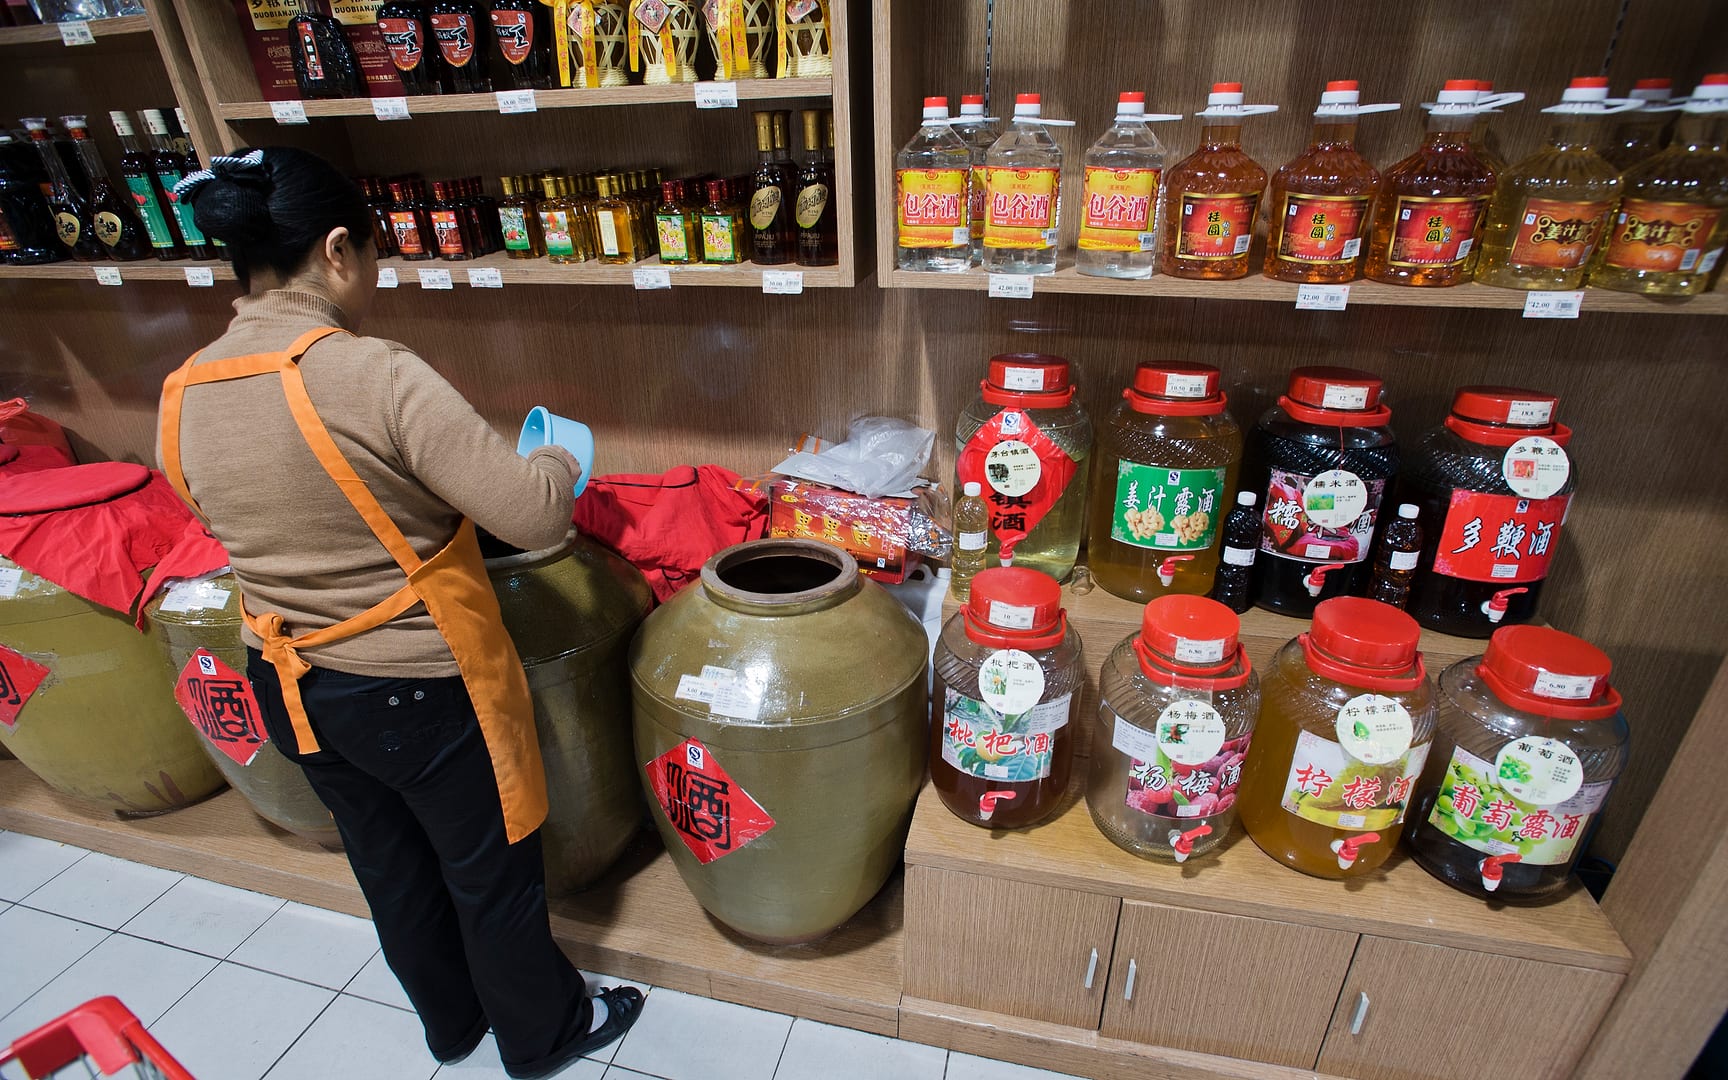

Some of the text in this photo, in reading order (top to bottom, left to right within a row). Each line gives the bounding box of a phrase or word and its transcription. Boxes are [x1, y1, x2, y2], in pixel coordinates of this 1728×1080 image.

[904, 192, 960, 219] 包谷酒
[993, 192, 1051, 219] 包谷酒
[1088, 192, 1150, 223] 包谷酒
[1515, 446, 1561, 456] 多鞭酒
[1313, 479, 1358, 488] 糯米酒
[1122, 480, 1216, 516] 姜汁露酒
[1452, 517, 1555, 560] 多鞭酒
[991, 658, 1035, 671] 枇杷酒
[1167, 710, 1215, 721] 杨梅酒
[1345, 703, 1397, 717] 柠檬酒
[948, 717, 1050, 756] 枇杷酒
[1517, 741, 1576, 766] 葡萄酒
[1135, 762, 1243, 796] 杨梅酒
[1295, 763, 1415, 809] 柠檬酒
[1452, 784, 1585, 840] 葡萄露酒
